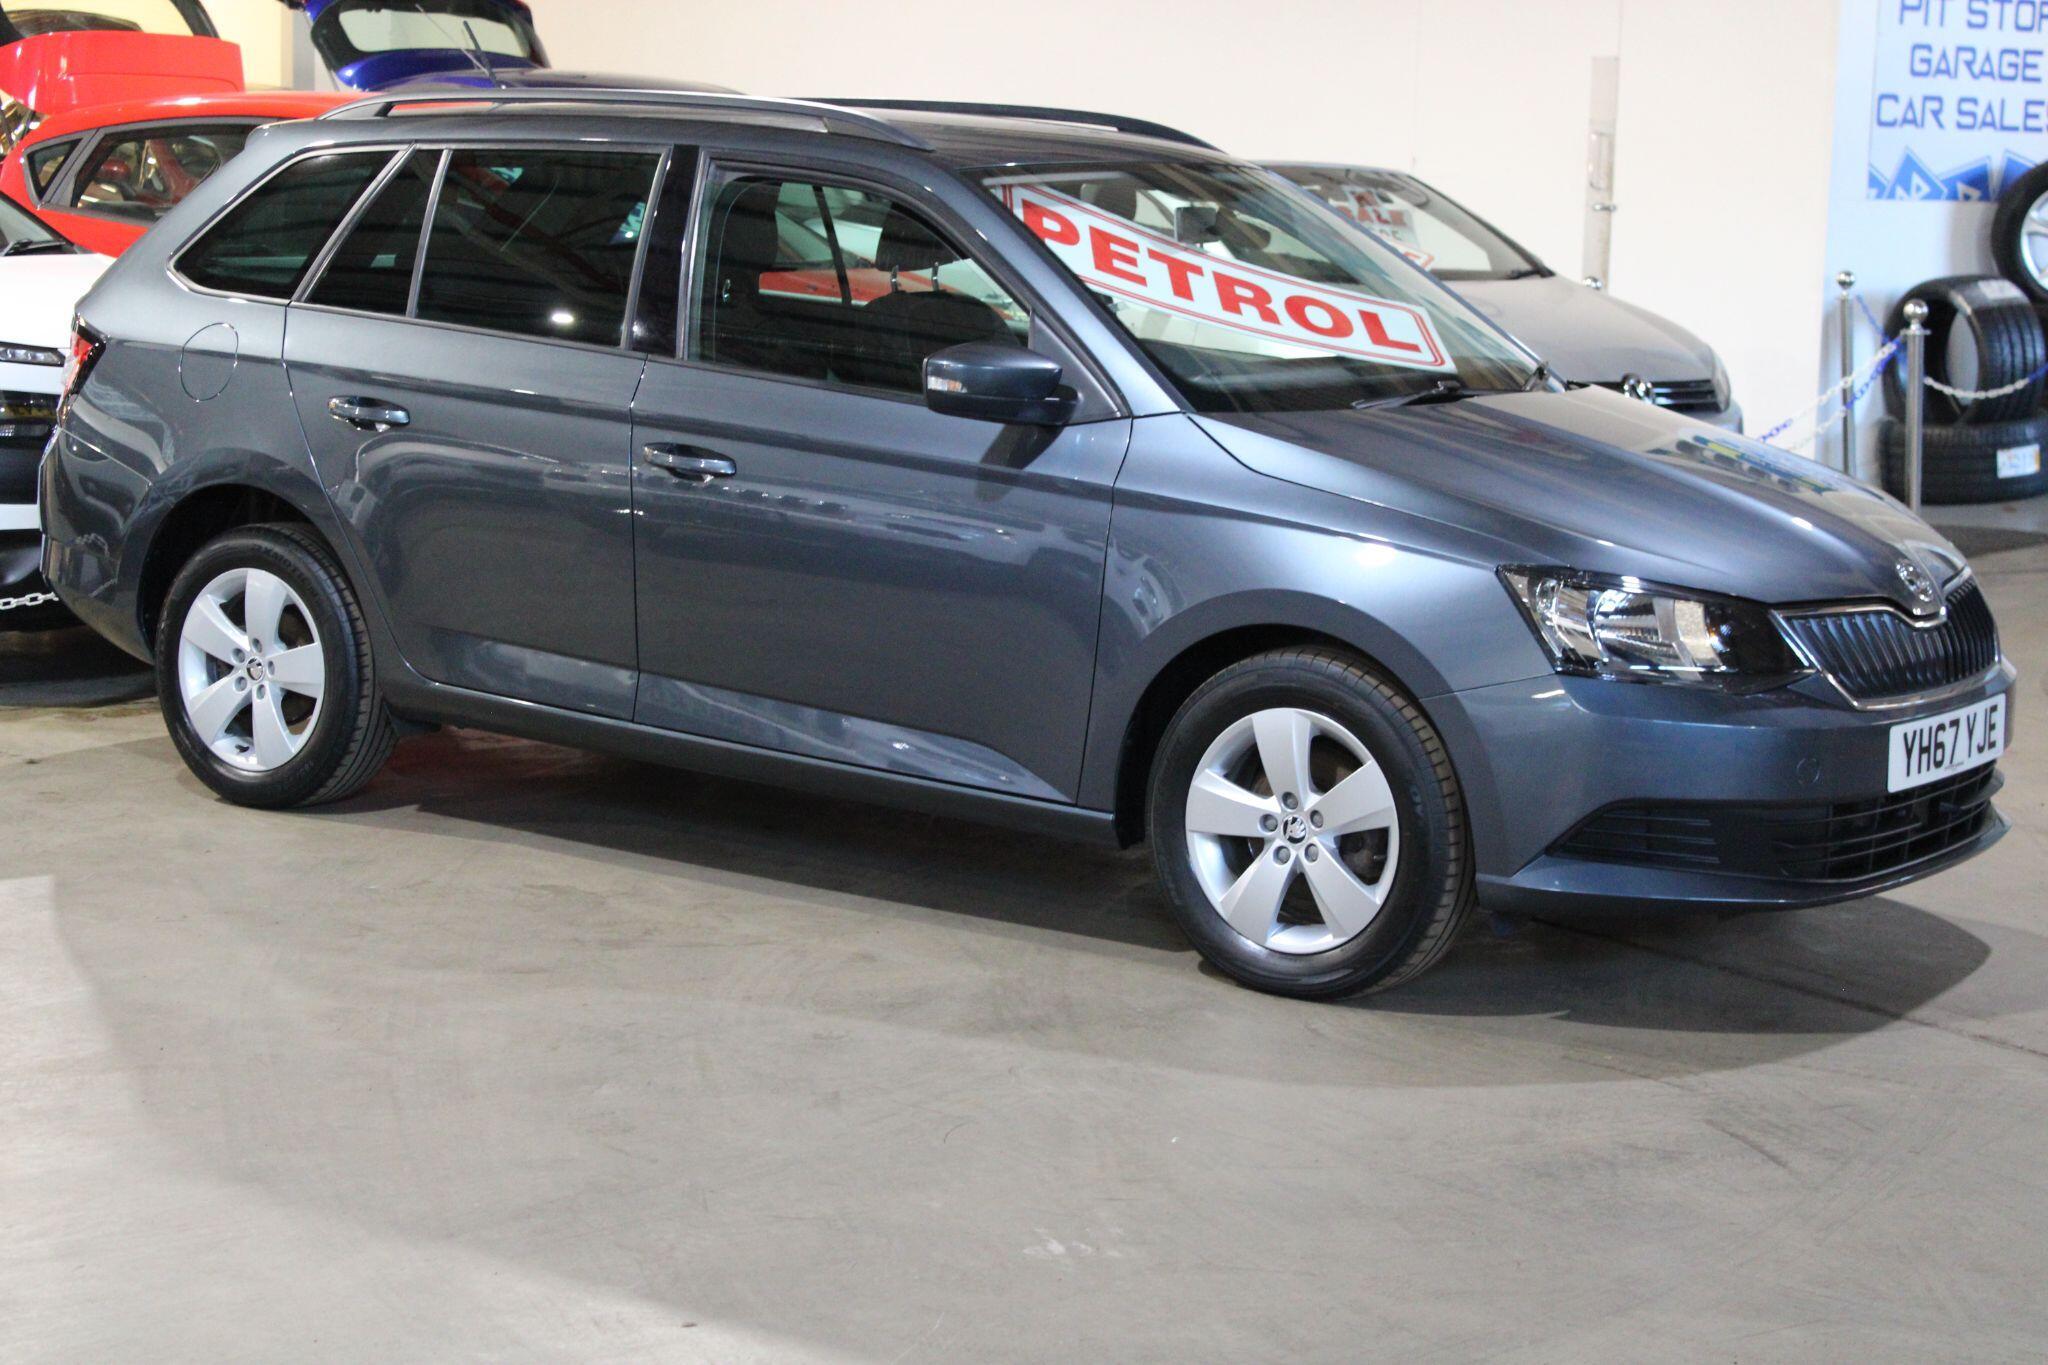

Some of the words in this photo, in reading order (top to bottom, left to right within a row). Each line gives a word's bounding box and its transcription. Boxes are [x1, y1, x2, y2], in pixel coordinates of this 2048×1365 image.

[1910, 44, 2043, 82] GARAGE
[1876, 92, 1945, 130] CAR
[1955, 96, 2048, 133] SALE
[1021, 199, 1422, 353] PETROL
[1903, 718, 1961, 777] YH67
[1966, 703, 1998, 759] YJE
